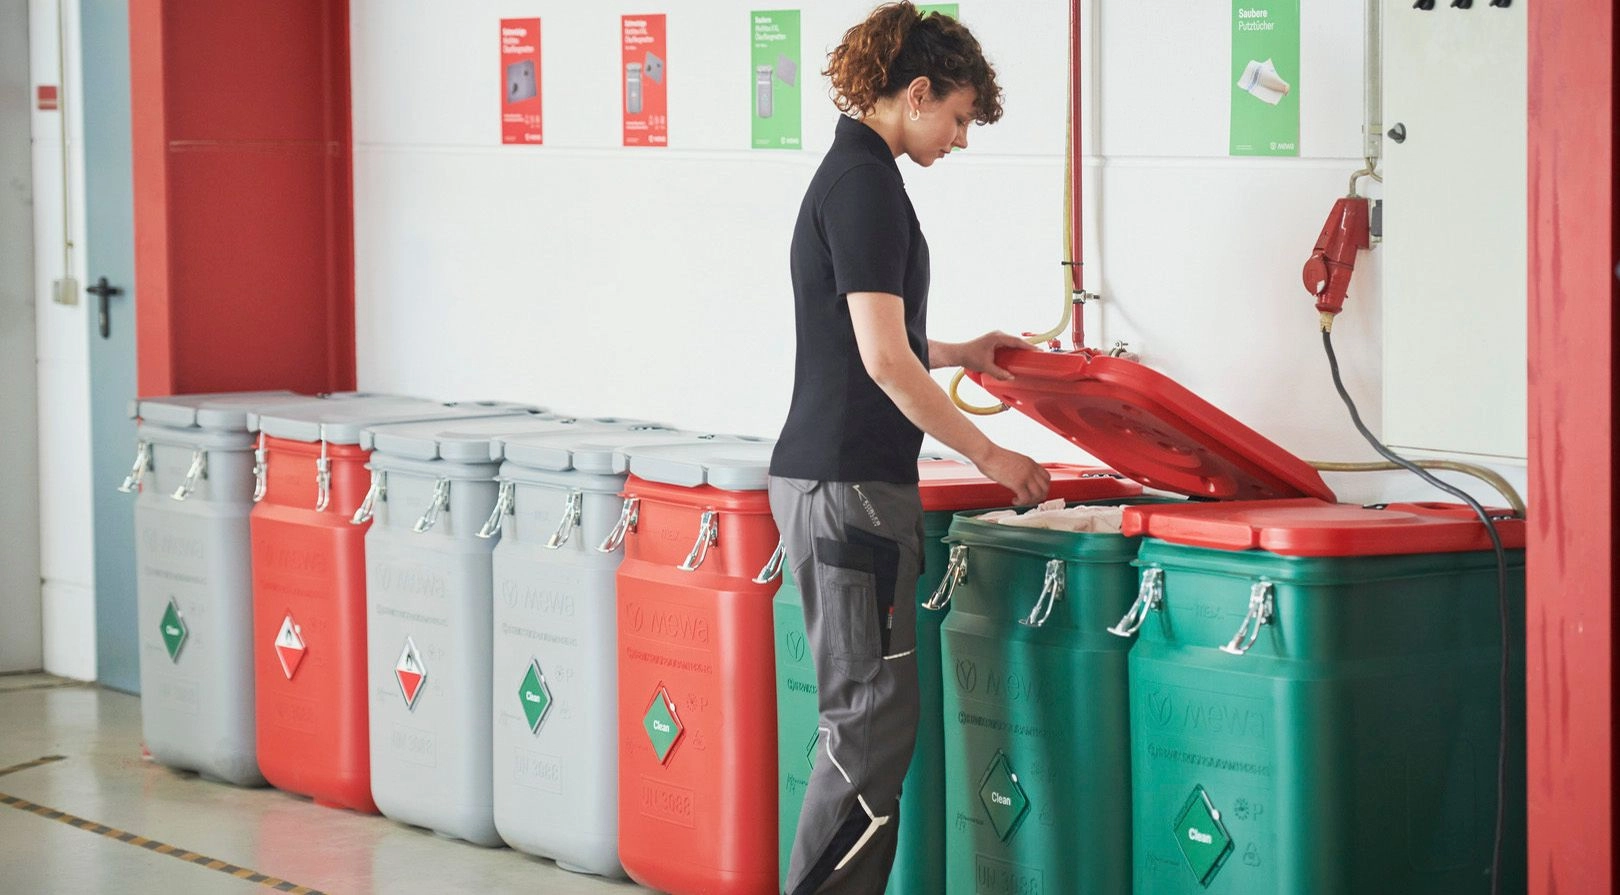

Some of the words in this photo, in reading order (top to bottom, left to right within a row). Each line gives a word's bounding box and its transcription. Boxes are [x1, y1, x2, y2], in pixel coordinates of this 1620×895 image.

[1238, 8, 1268, 18] Saubere
[1238, 20, 1274, 31] Putztücher
[525, 690, 541, 703] Clean
[653, 719, 670, 733] Clean
[991, 791, 1011, 806] Clean
[1188, 827, 1212, 845] Clean
